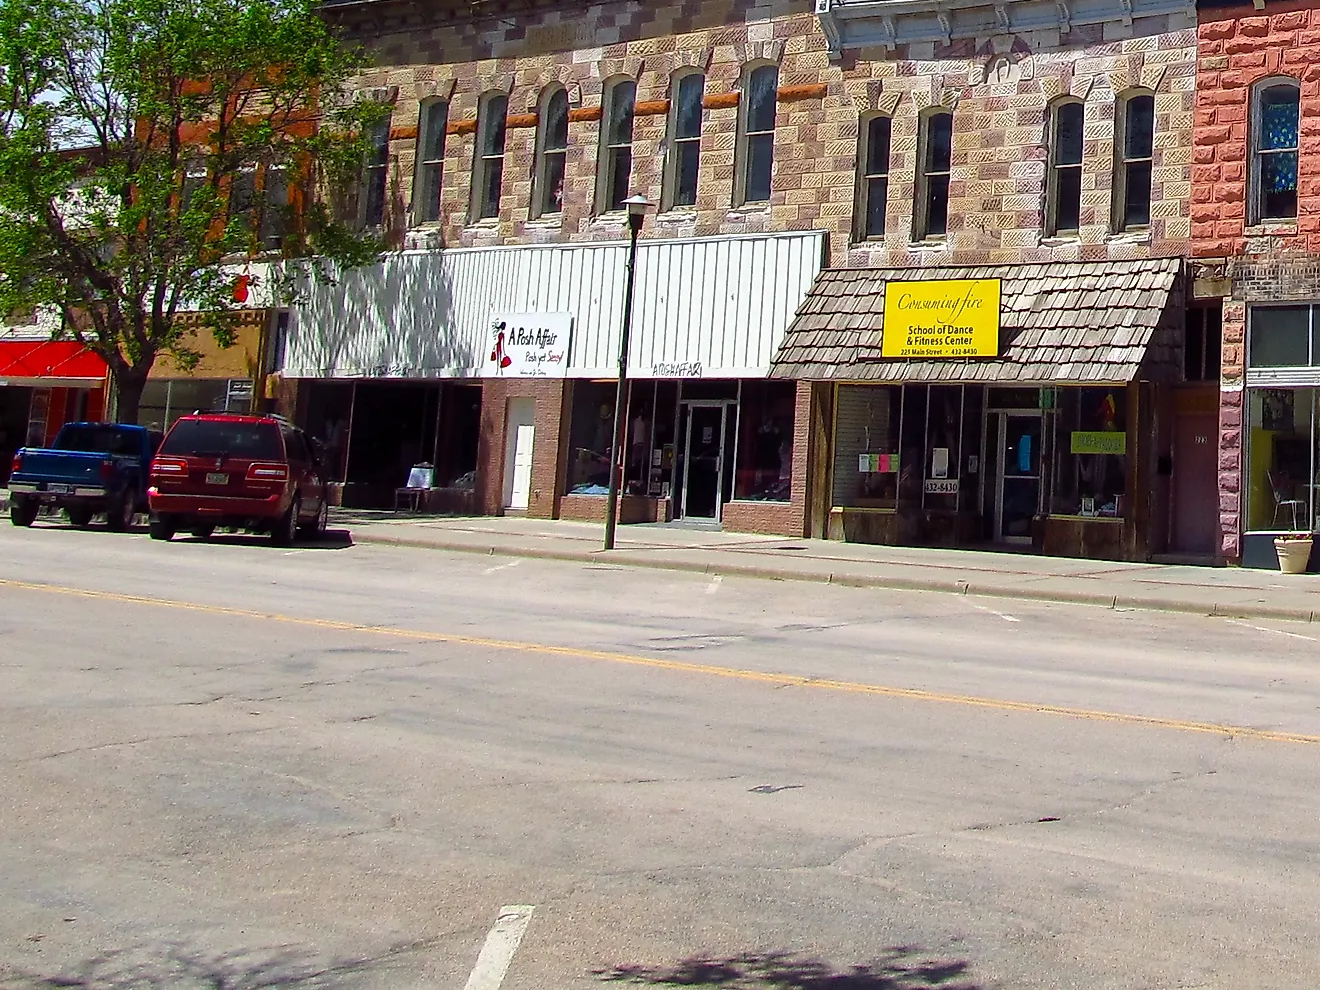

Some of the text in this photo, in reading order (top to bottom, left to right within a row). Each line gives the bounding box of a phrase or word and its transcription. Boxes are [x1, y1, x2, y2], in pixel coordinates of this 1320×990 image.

[897, 281, 983, 324] Consuming fire
[508, 327, 558, 349] A Posh Affair
[908, 325, 974, 335] School of Dance
[906, 336, 973, 346] & Fitness Center
